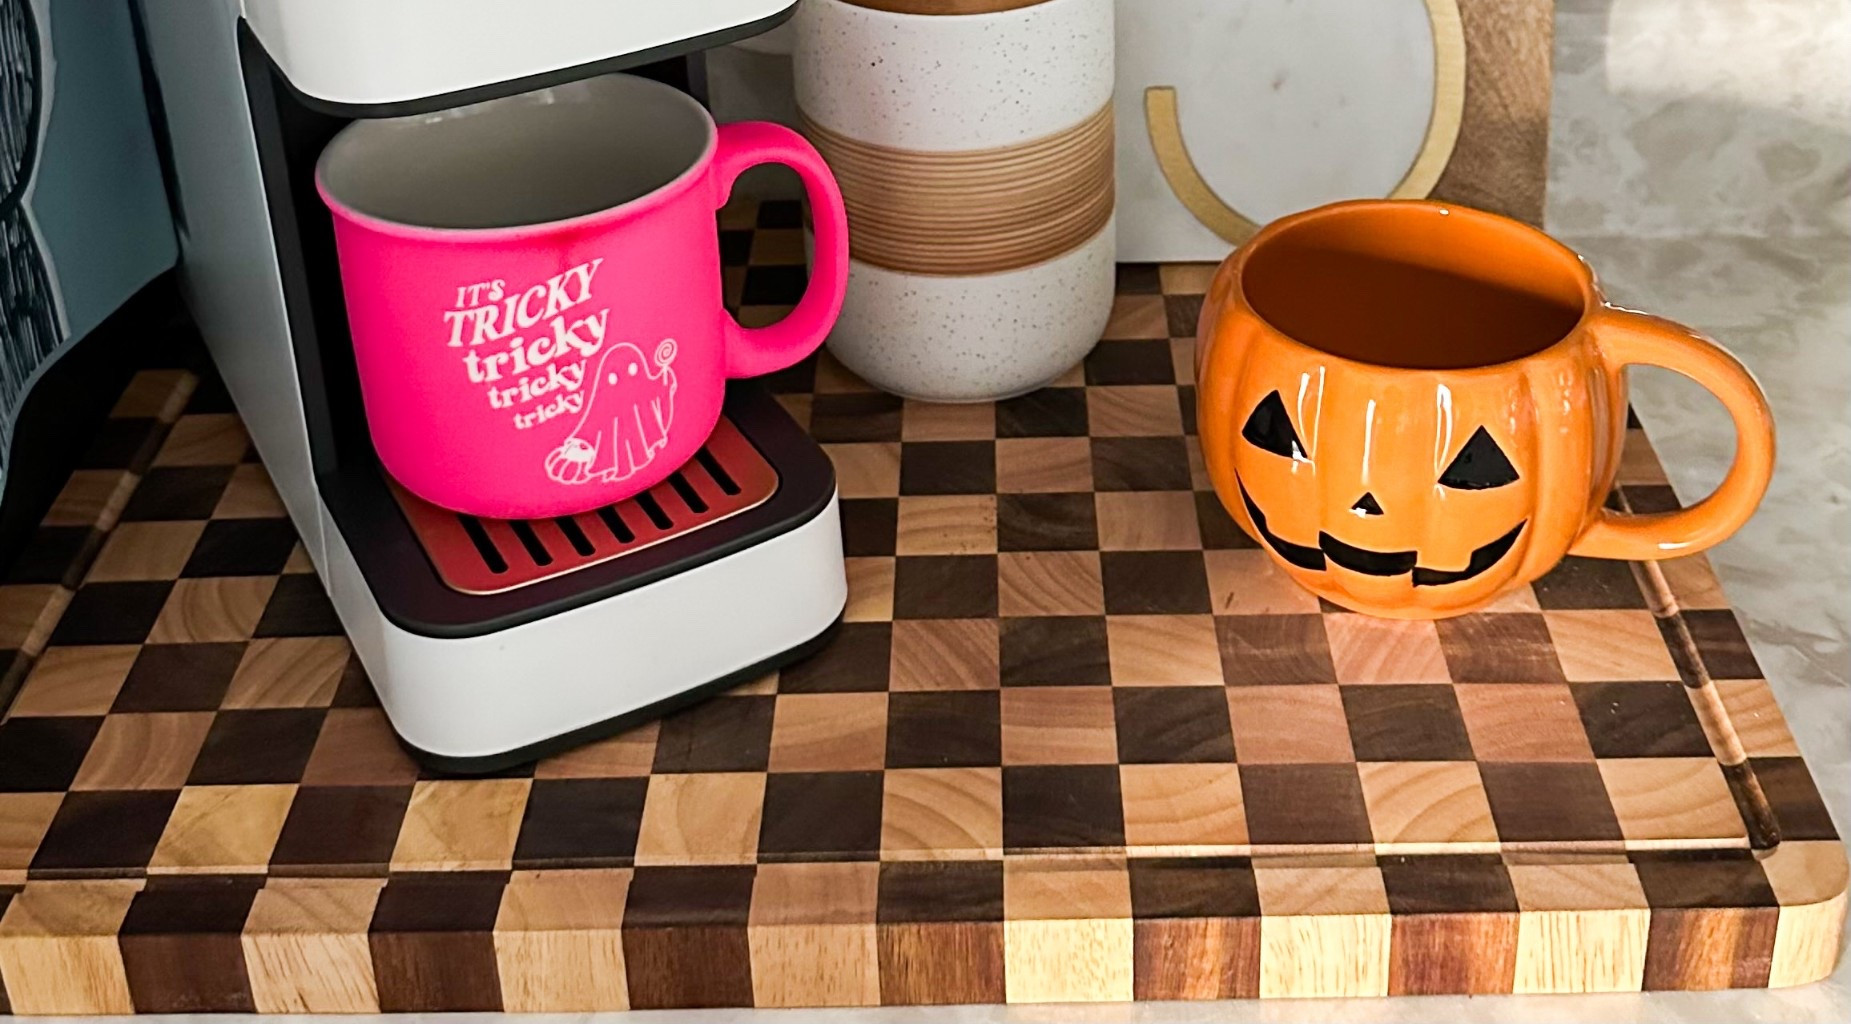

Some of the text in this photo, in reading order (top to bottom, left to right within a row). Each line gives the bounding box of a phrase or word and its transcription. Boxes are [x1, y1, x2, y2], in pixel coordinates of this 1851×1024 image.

[443, 257, 604, 347] TRICKY
[454, 279, 506, 308] IT'S
[462, 307, 610, 383] tricky
[487, 359, 587, 409] tricky
[513, 389, 585, 430] tricky
